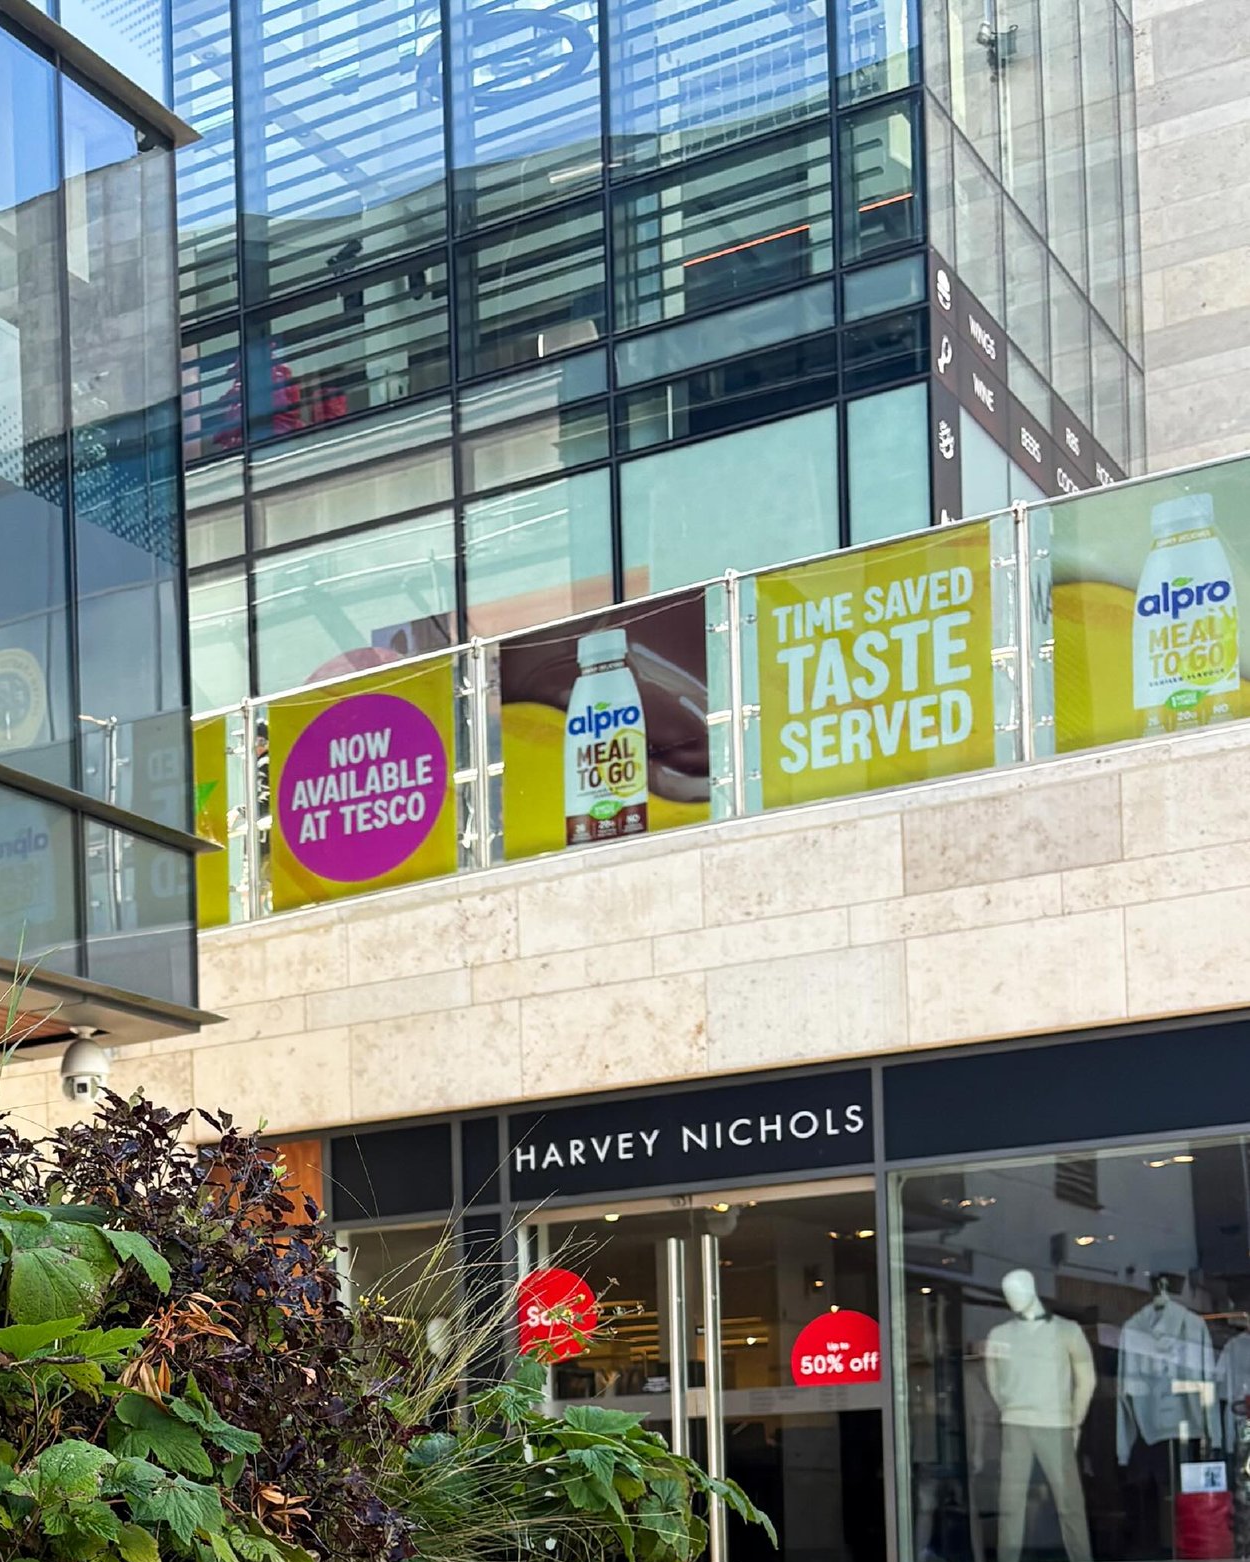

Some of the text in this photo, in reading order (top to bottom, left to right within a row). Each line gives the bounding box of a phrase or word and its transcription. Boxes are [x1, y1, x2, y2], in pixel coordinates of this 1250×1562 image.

[772, 566, 974, 643] TIME SAVED
[1137, 580, 1231, 619] alpro
[1149, 614, 1224, 652] MEAL
[776, 610, 972, 715] TASTE
[1150, 650, 1180, 678] TO
[1188, 641, 1224, 670] GO
[568, 705, 640, 738] alpro
[780, 689, 974, 774] SERVED
[329, 728, 392, 767] NOW
[577, 738, 635, 767] MEAL
[292, 754, 433, 811] AVAILABLE
[577, 761, 635, 790] TO GO
[299, 792, 425, 844] AT TESCO
[515, 1105, 864, 1172] HARVEY NICHOLS
[800, 1351, 879, 1375] 50% off
